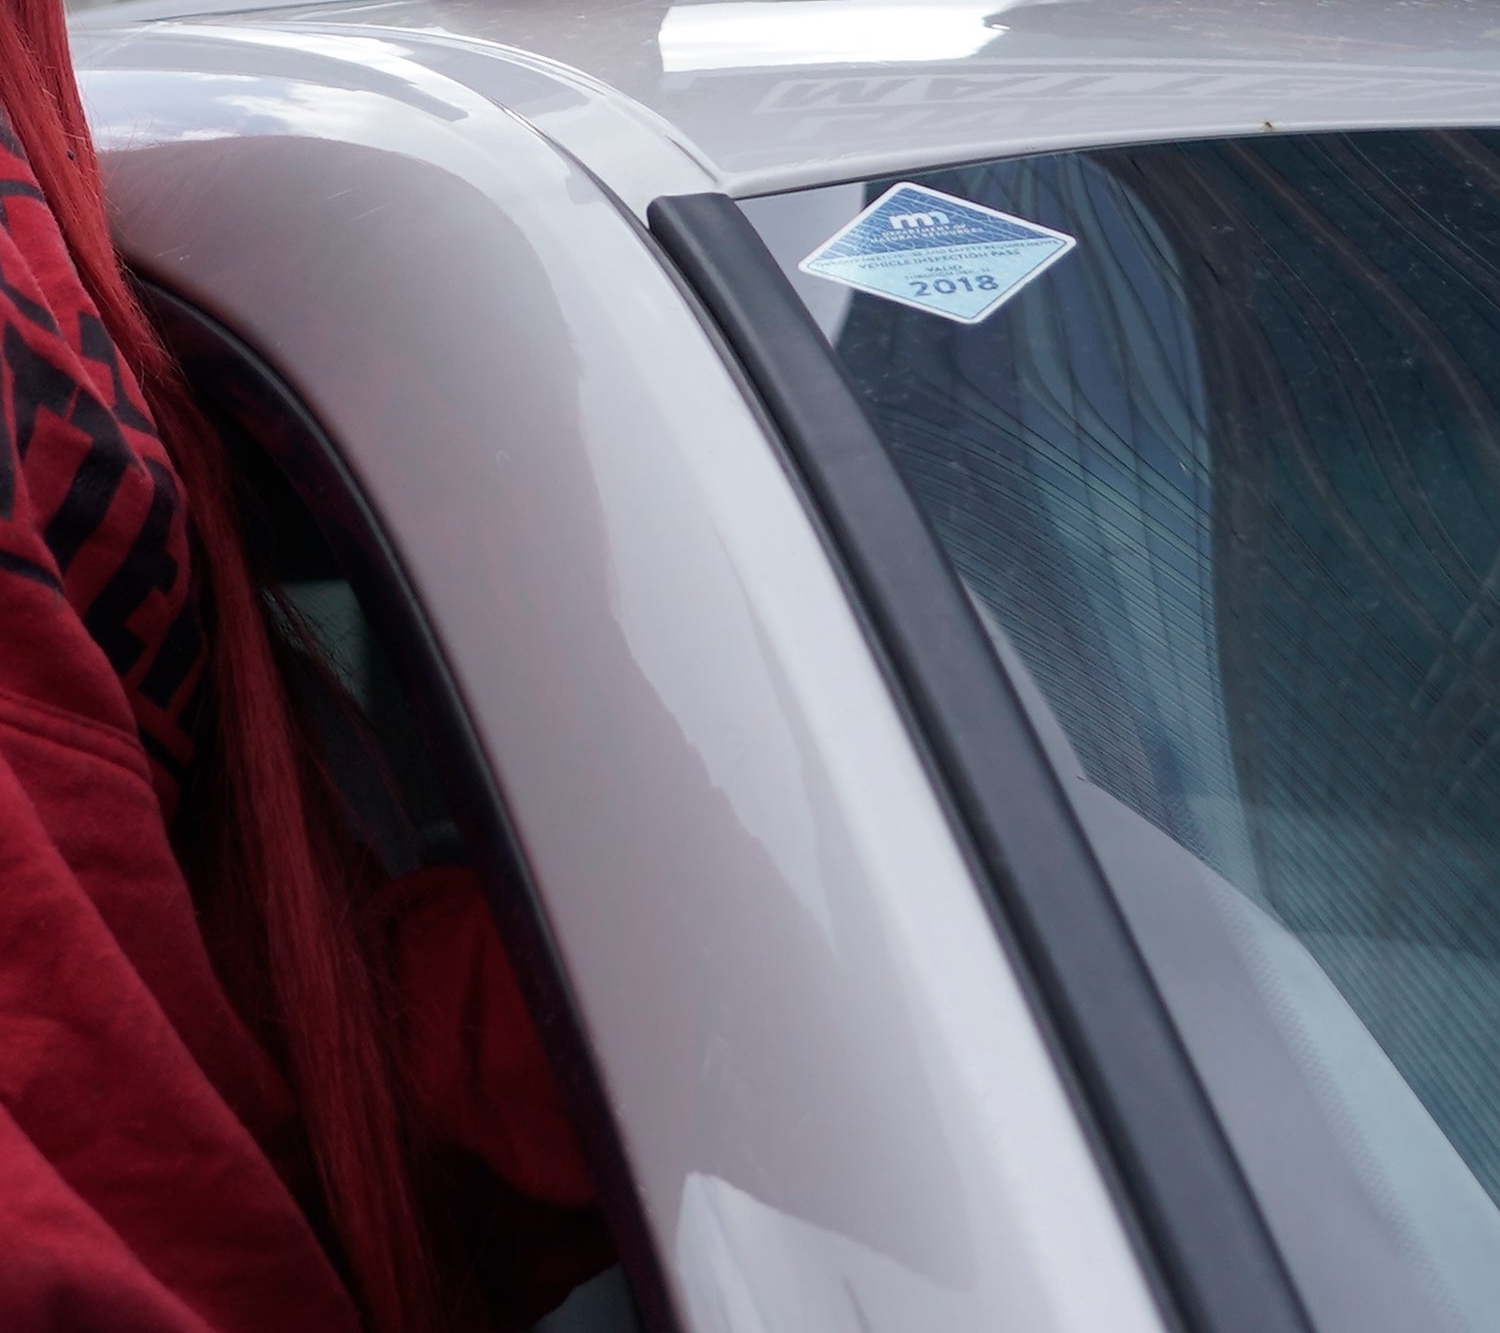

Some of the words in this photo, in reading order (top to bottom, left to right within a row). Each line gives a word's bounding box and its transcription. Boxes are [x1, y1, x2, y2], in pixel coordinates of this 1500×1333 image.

[858, 257, 909, 270] VEHICLE
[911, 250, 988, 265] INSPECTION
[925, 264, 963, 274] VALID
[908, 274, 999, 298] 2018
